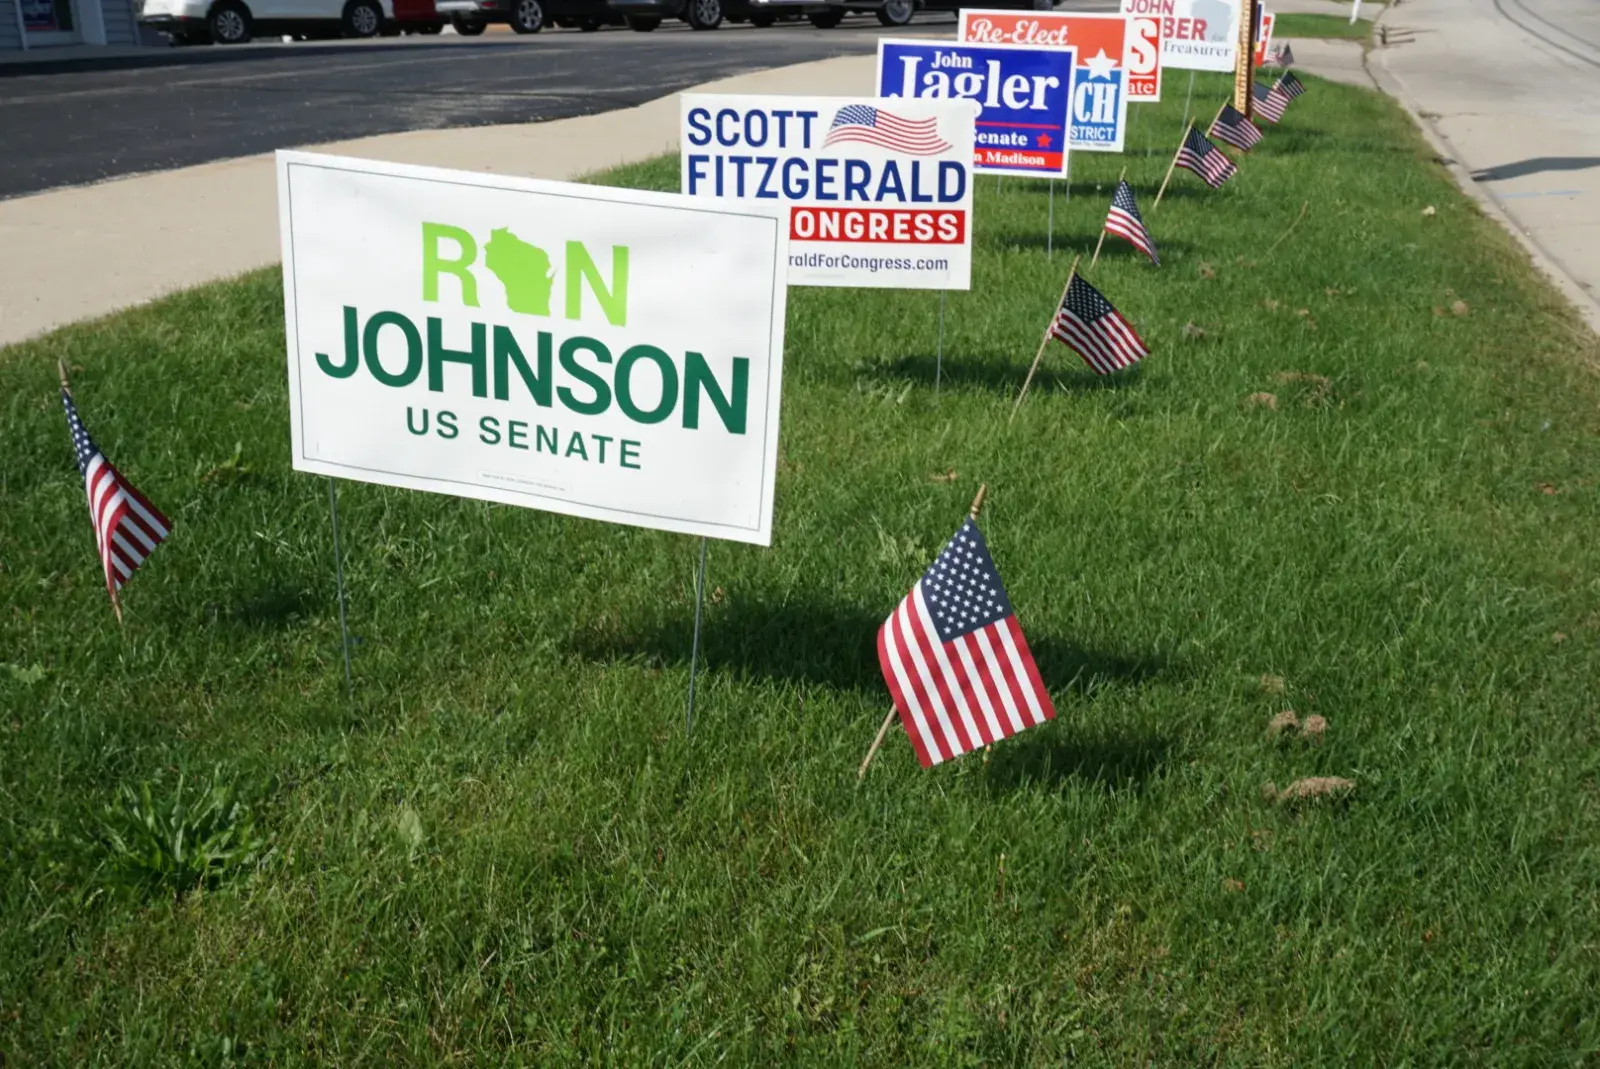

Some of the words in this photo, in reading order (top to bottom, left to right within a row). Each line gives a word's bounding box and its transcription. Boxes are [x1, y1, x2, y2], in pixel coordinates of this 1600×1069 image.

[1126, 0, 1175, 15] JOHN
[967, 18, 1068, 45] Re-Elect
[931, 51, 972, 69] John
[1163, 41, 1232, 57] Treasurer
[889, 56, 1060, 118] Jagler
[1126, 80, 1155, 94] ate
[687, 108, 818, 149] SCOTT
[1070, 126, 1115, 140] STRICT
[986, 151, 1045, 165] Madison
[688, 154, 967, 203] FITZGERALD
[794, 210, 958, 241] ONGRESS
[789, 253, 949, 272] raldForCongress.com
[314, 305, 750, 436] JOHNSON
[406, 407, 460, 438] US
[478, 417, 642, 470] SENATE
